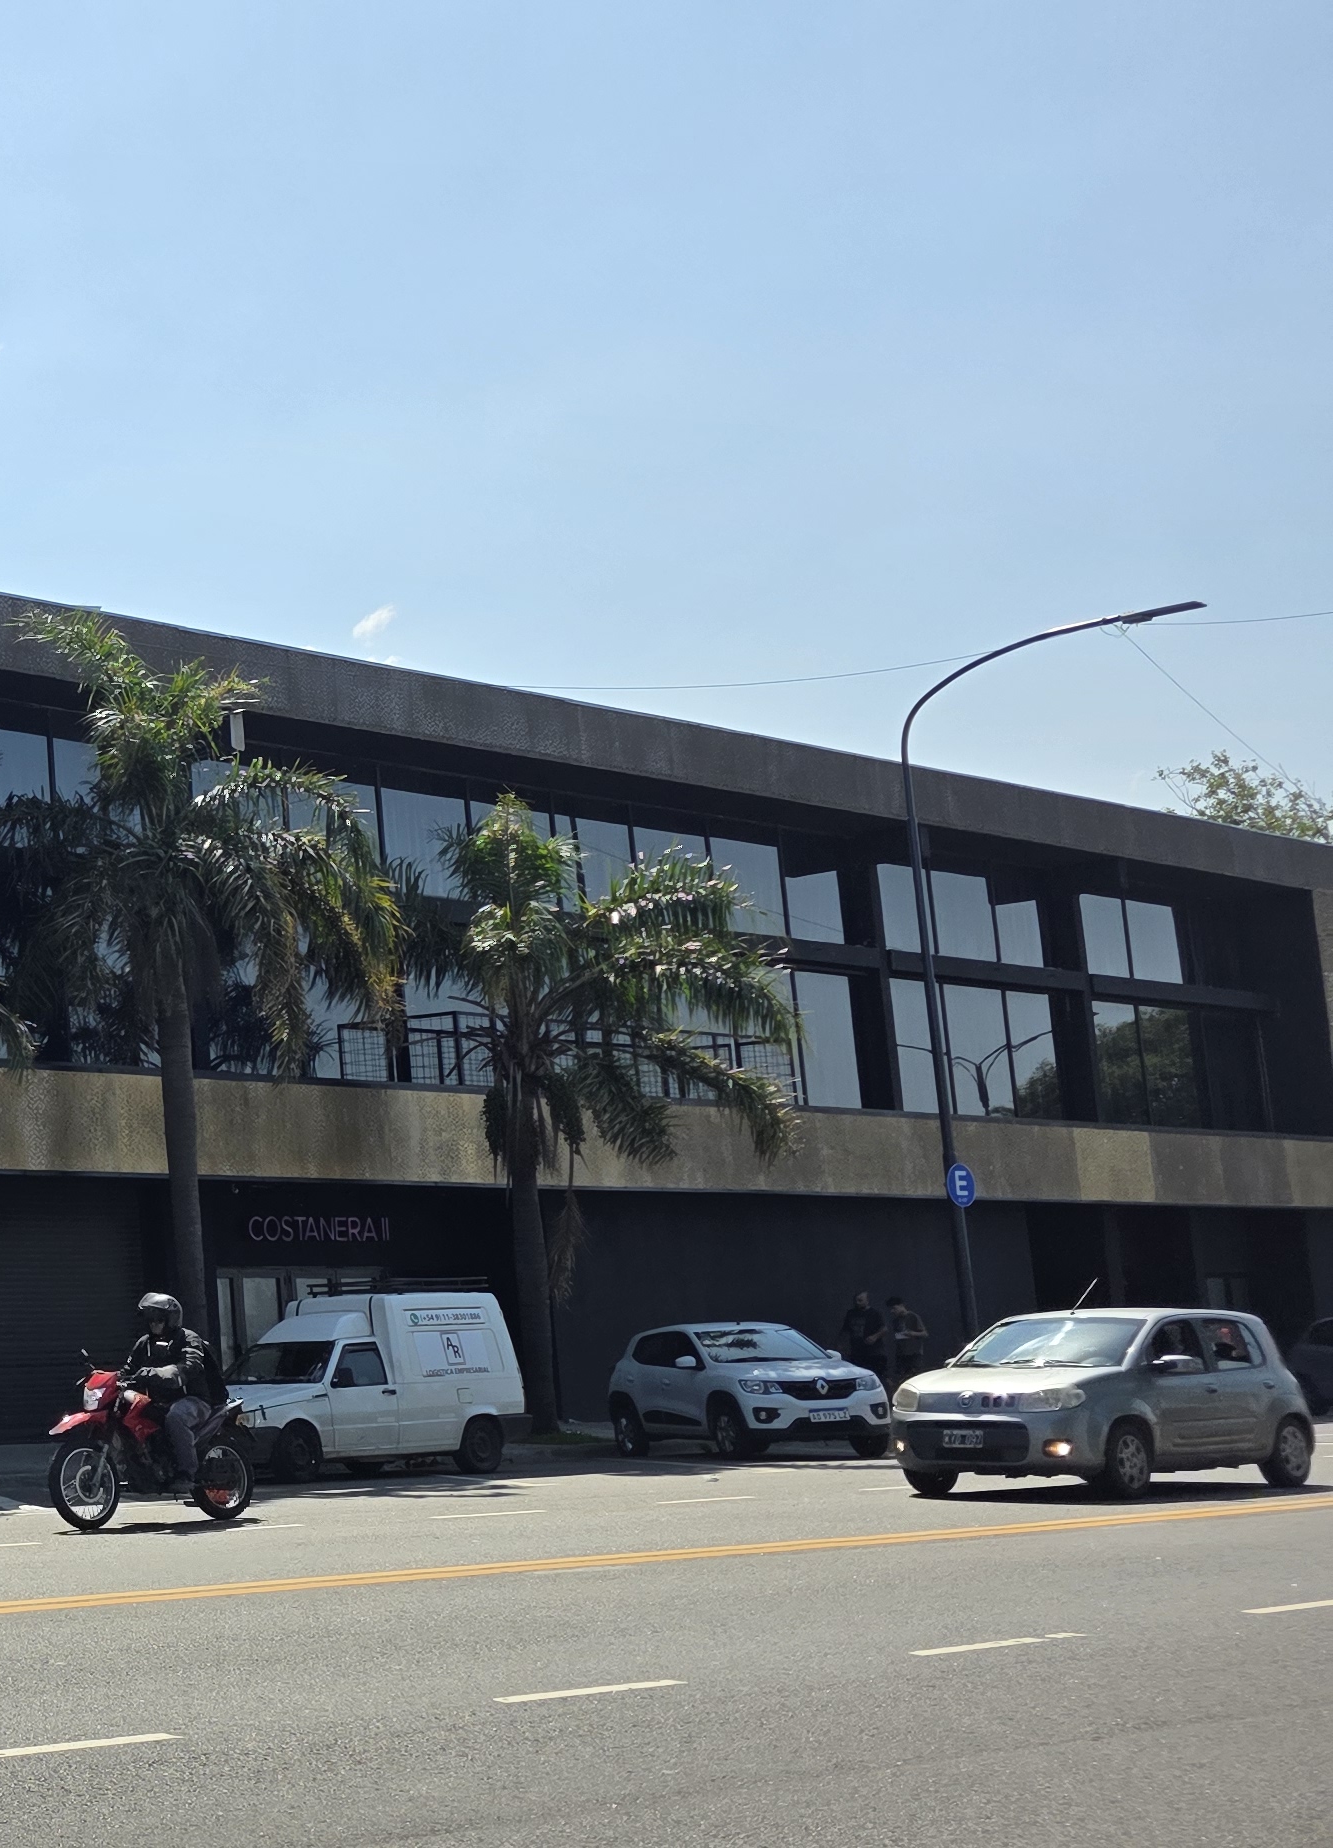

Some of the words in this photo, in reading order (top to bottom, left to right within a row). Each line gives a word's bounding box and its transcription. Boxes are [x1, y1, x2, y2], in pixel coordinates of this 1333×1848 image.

[955, 1171, 968, 1195] E
[248, 1216, 378, 1241] COSTANERA
[381, 1217, 390, 1240] II
